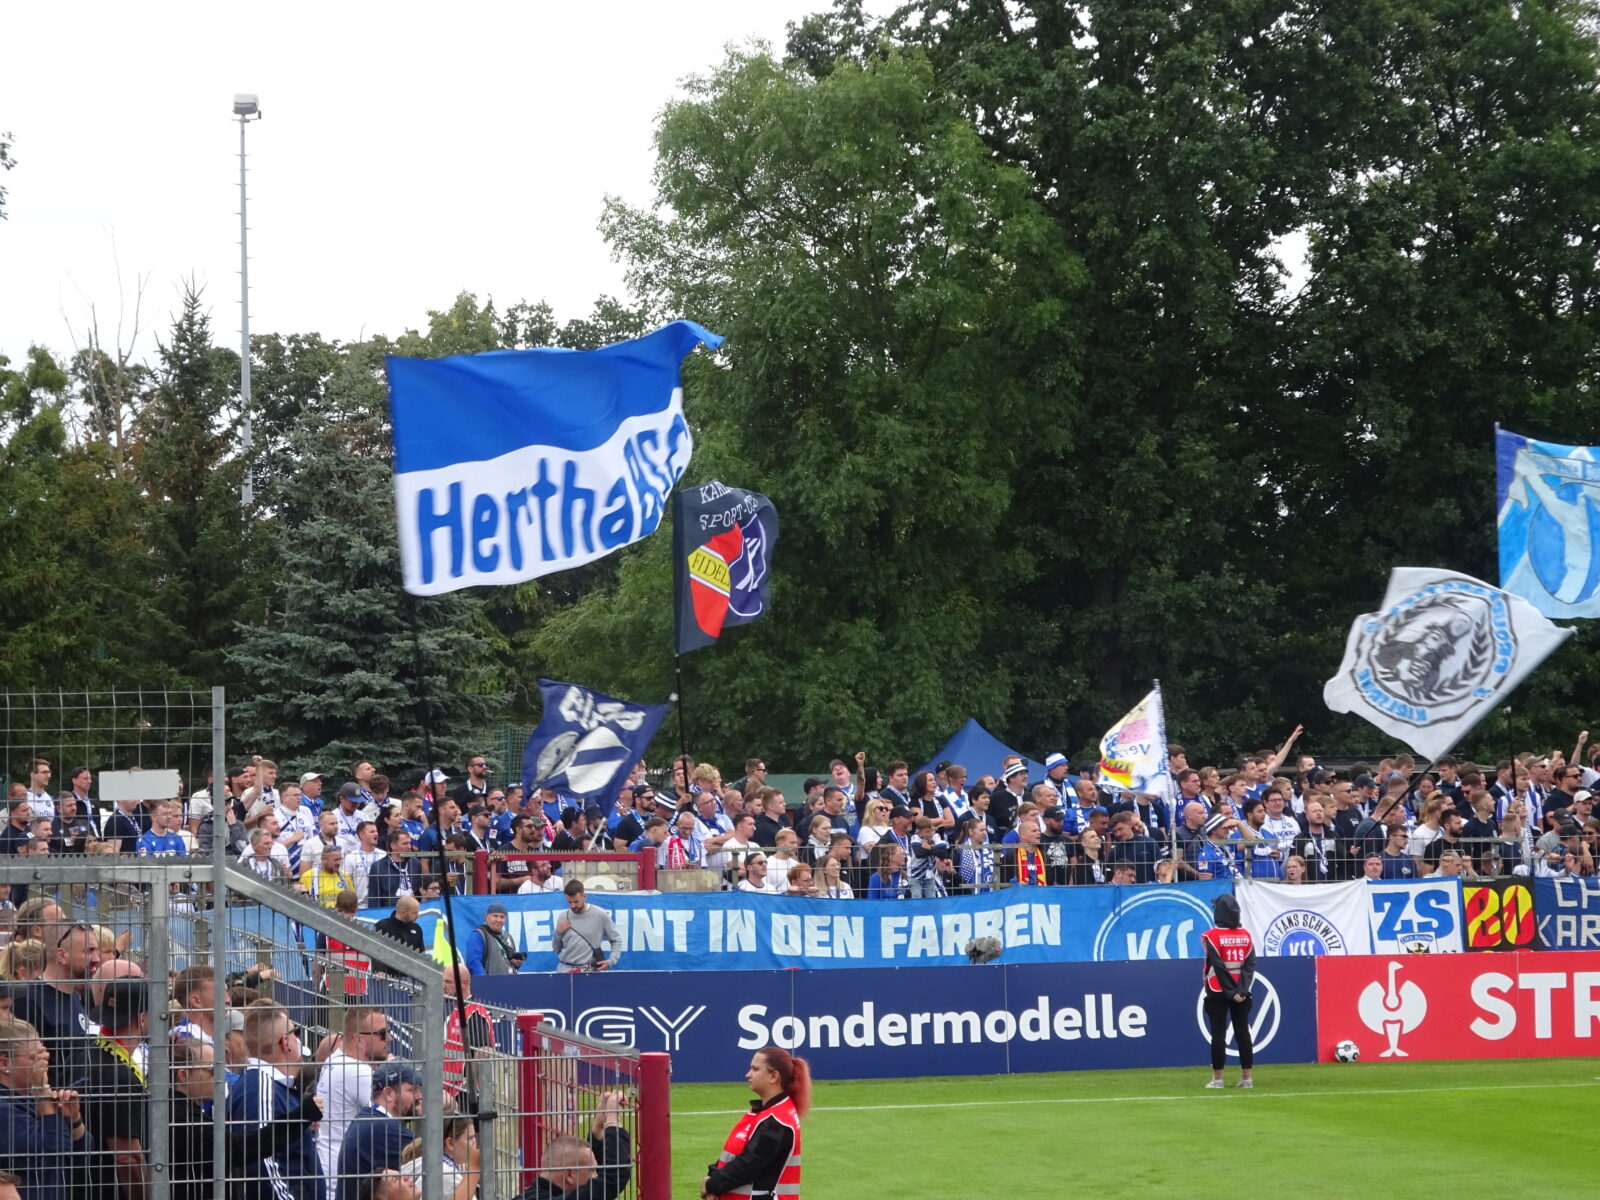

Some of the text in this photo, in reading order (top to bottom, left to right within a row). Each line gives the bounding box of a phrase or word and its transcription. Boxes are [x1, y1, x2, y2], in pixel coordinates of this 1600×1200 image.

[418, 457, 633, 585] Hertha
[709, 909, 757, 953] IN
[771, 912, 864, 958] DEN
[880, 903, 1061, 959] FARBEN
[1219, 936, 1250, 946] SECURITY
[1226, 948, 1245, 961] 119
[1275, 913, 1300, 935] FANS
[1302, 913, 1342, 951] SCHWEIZ
[737, 993, 1147, 1051] Sondermodelle
